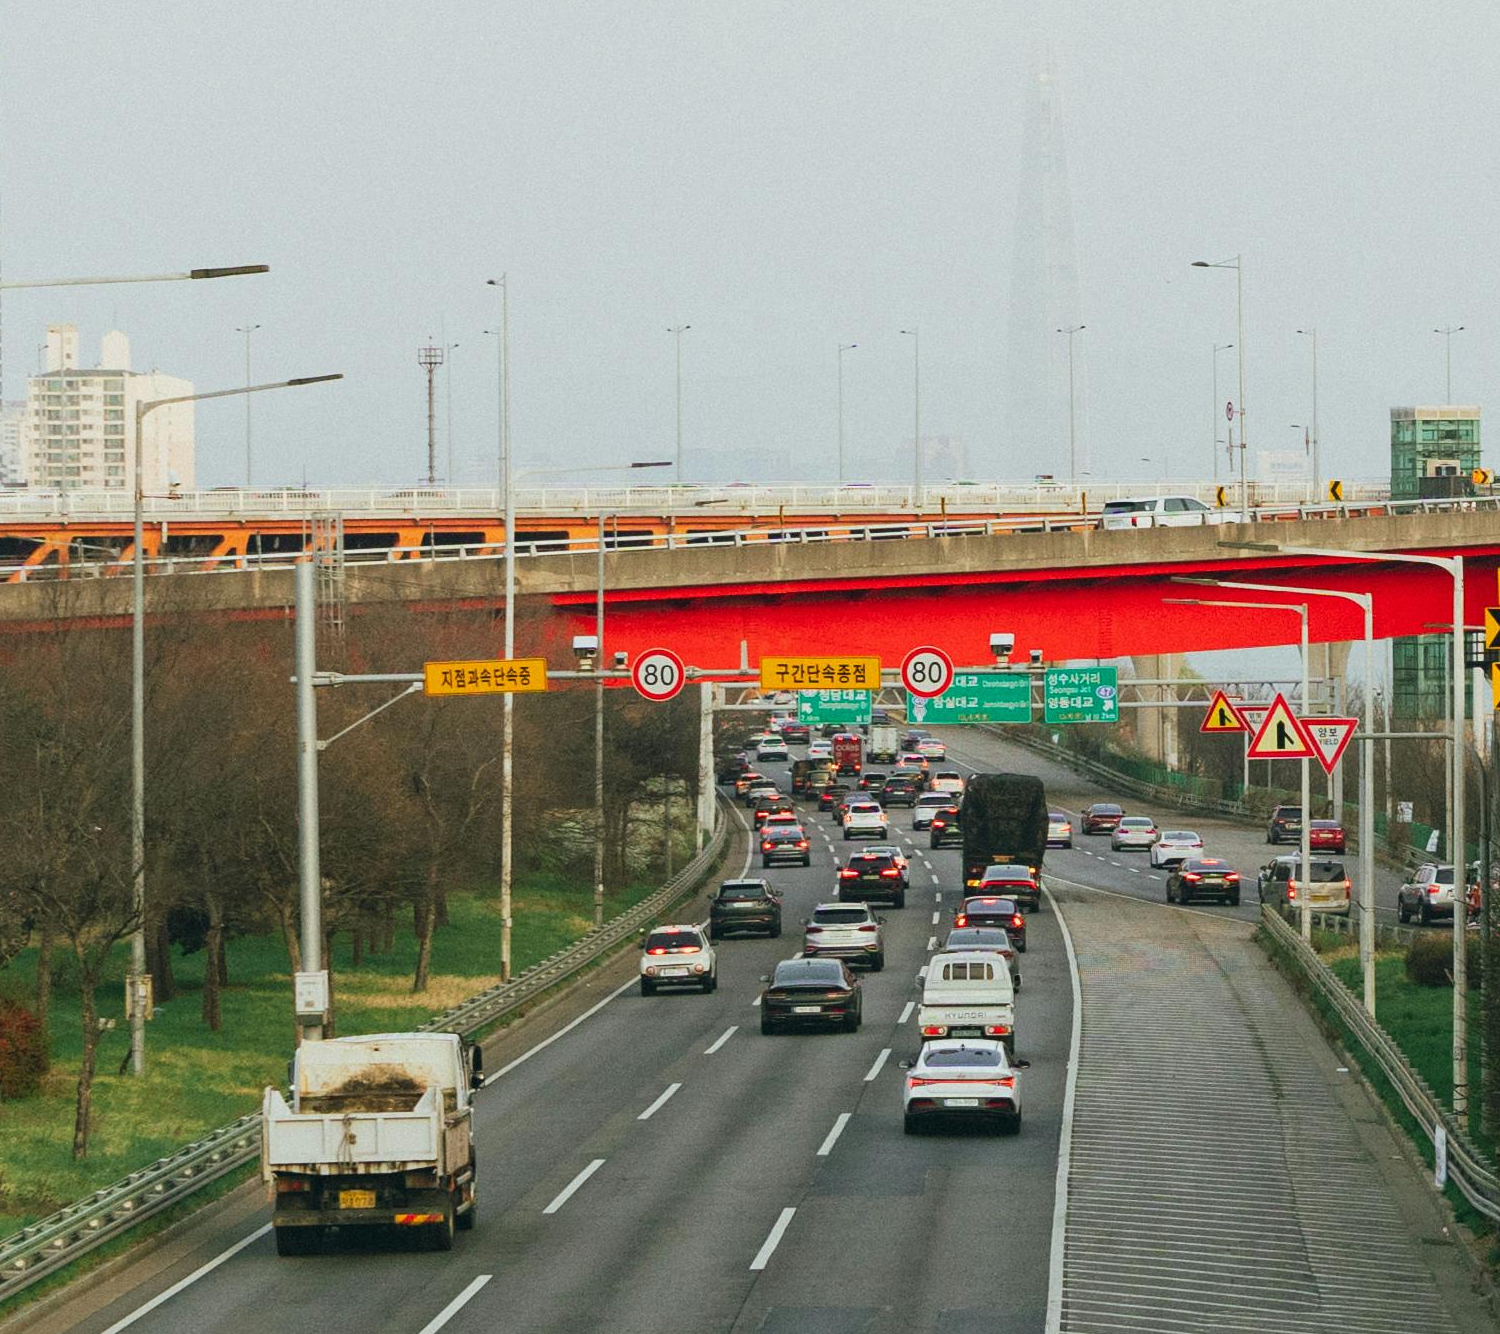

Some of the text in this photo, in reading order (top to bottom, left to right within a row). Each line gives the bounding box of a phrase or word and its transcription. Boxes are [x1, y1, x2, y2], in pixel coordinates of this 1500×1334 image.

[441, 666, 530, 688] 지점과속단속중
[644, 664, 674, 686] 80
[775, 663, 866, 683] 구간단속종점
[912, 661, 942, 683] 80
[1048, 672, 1100, 686] 성수사거리
[1318, 727, 1338, 738] 양보
